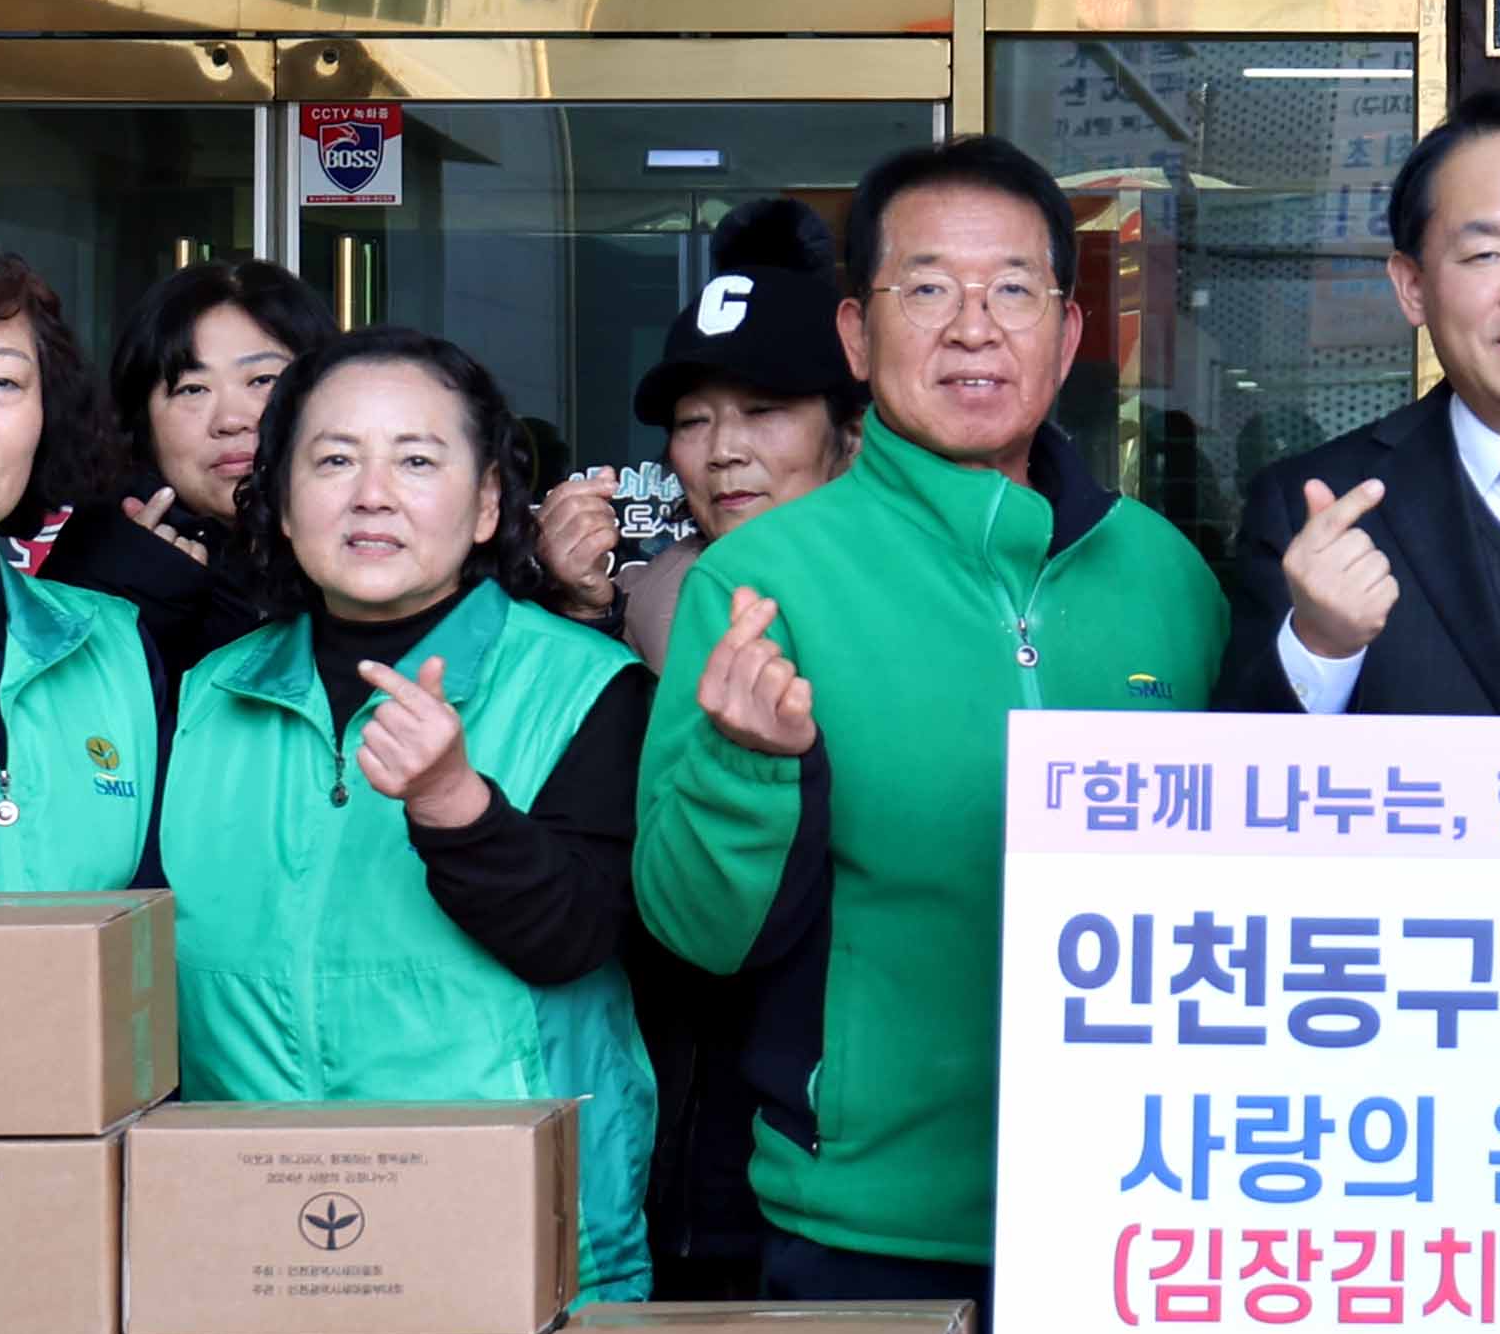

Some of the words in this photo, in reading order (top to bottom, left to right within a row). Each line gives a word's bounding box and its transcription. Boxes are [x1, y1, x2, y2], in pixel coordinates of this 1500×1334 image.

[311, 107, 351, 121] CCTV
[324, 148, 378, 169] BOSS
[696, 273, 754, 336] C
[1126, 680, 1173, 700] SMU
[93, 778, 137, 798] SMU
[1244, 762, 1470, 843] 나누는,
[1057, 910, 1500, 1051] 인천동구
[1118, 1093, 1438, 1203] 사랑의
[1111, 1222, 1499, 1328] (김장김치
